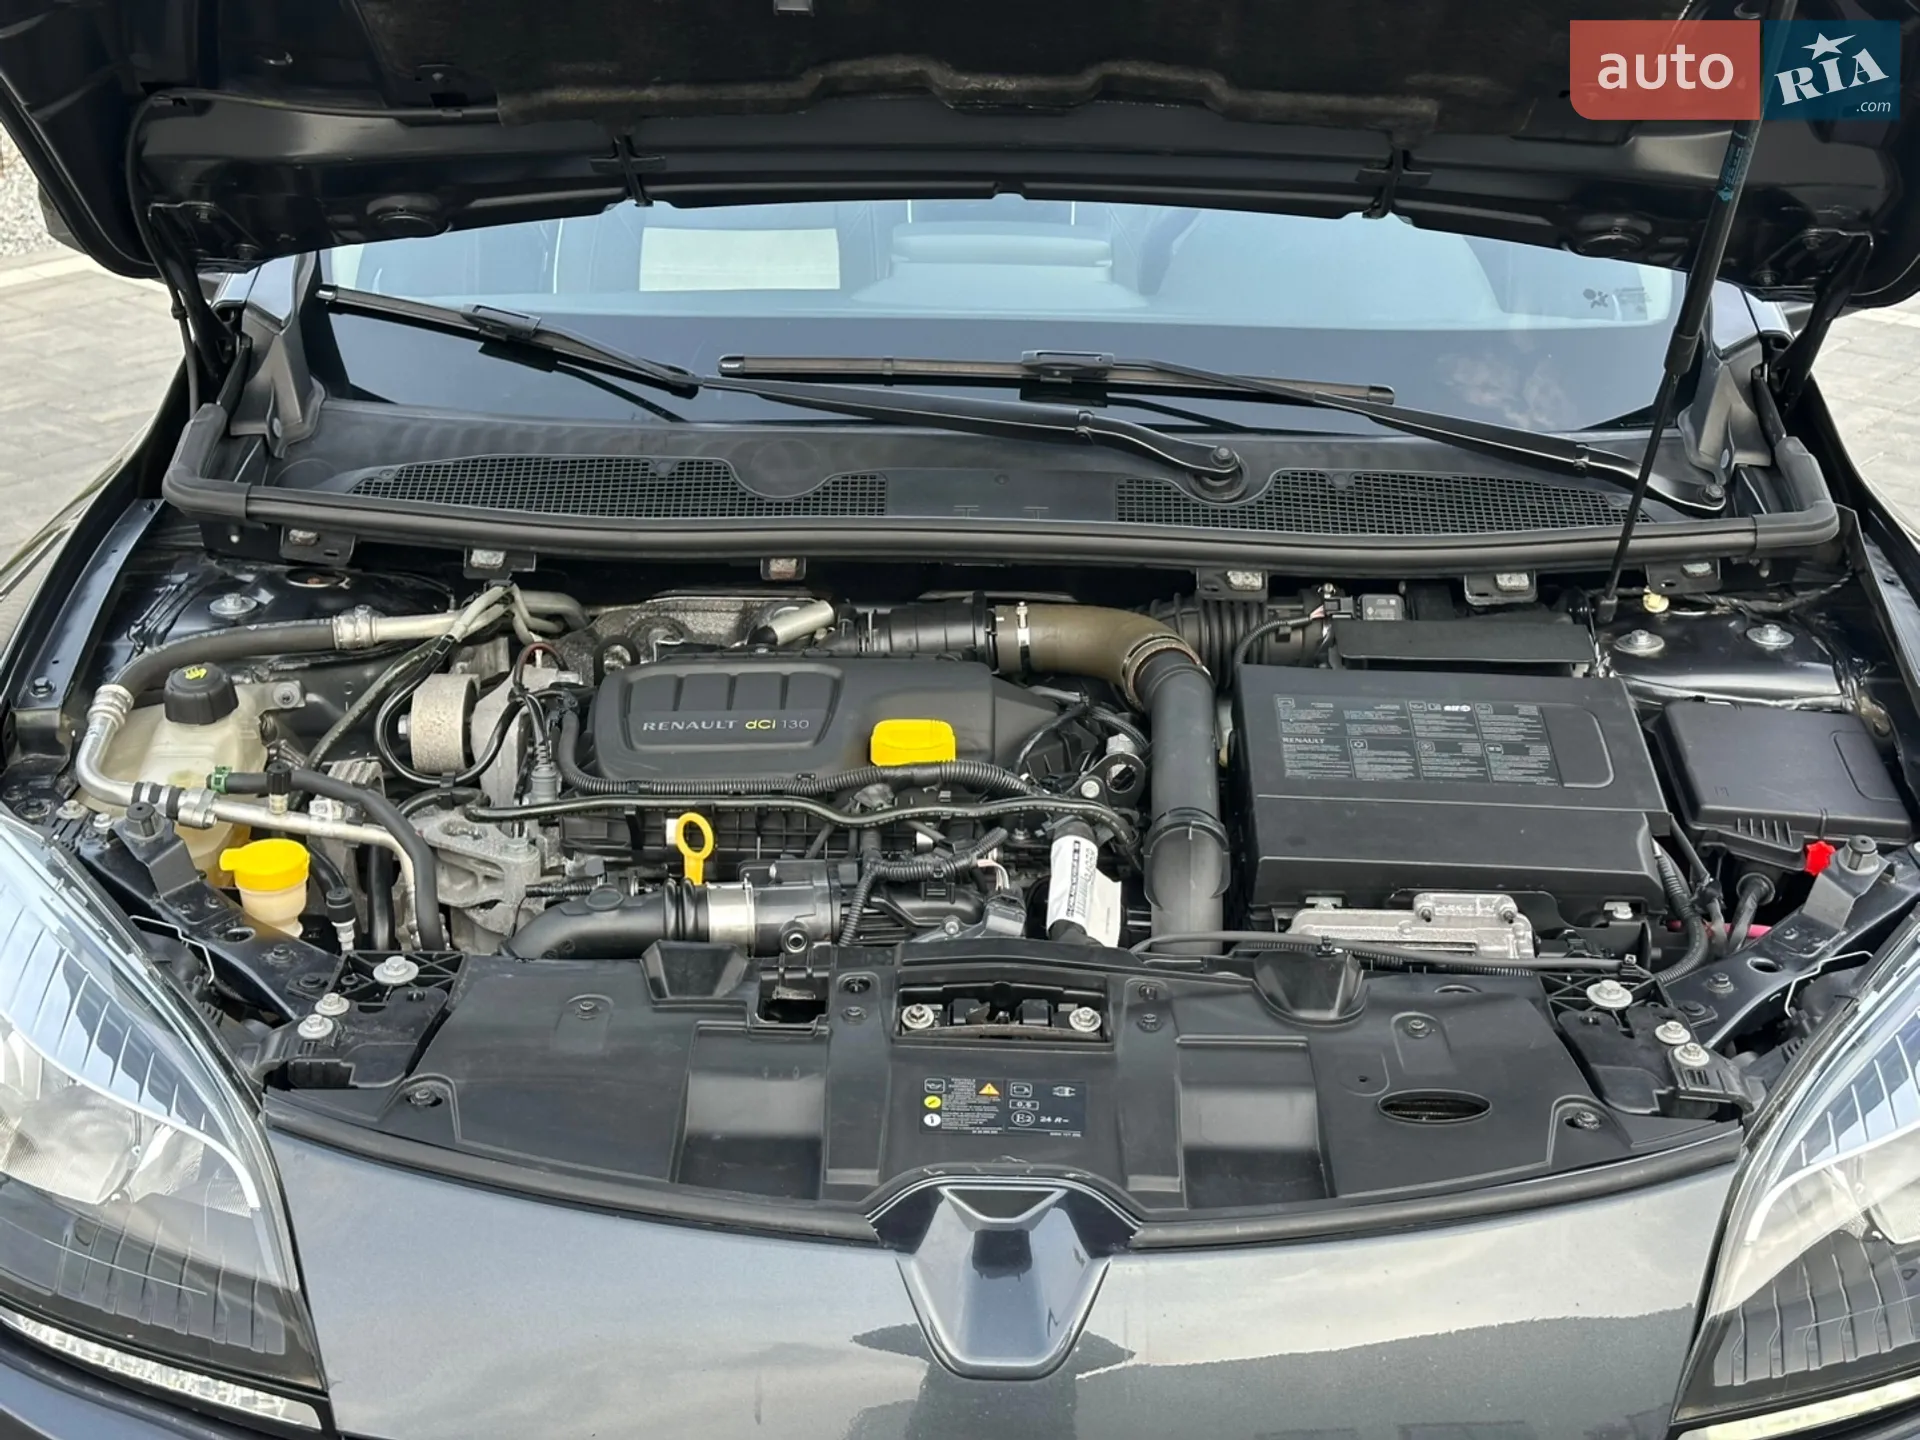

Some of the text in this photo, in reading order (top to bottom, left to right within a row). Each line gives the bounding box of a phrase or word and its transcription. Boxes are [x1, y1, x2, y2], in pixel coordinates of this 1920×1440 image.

[642, 719, 738, 731] RENAULT
[781, 719, 810, 730] 130
[1281, 736, 1326, 746] RENAULT
